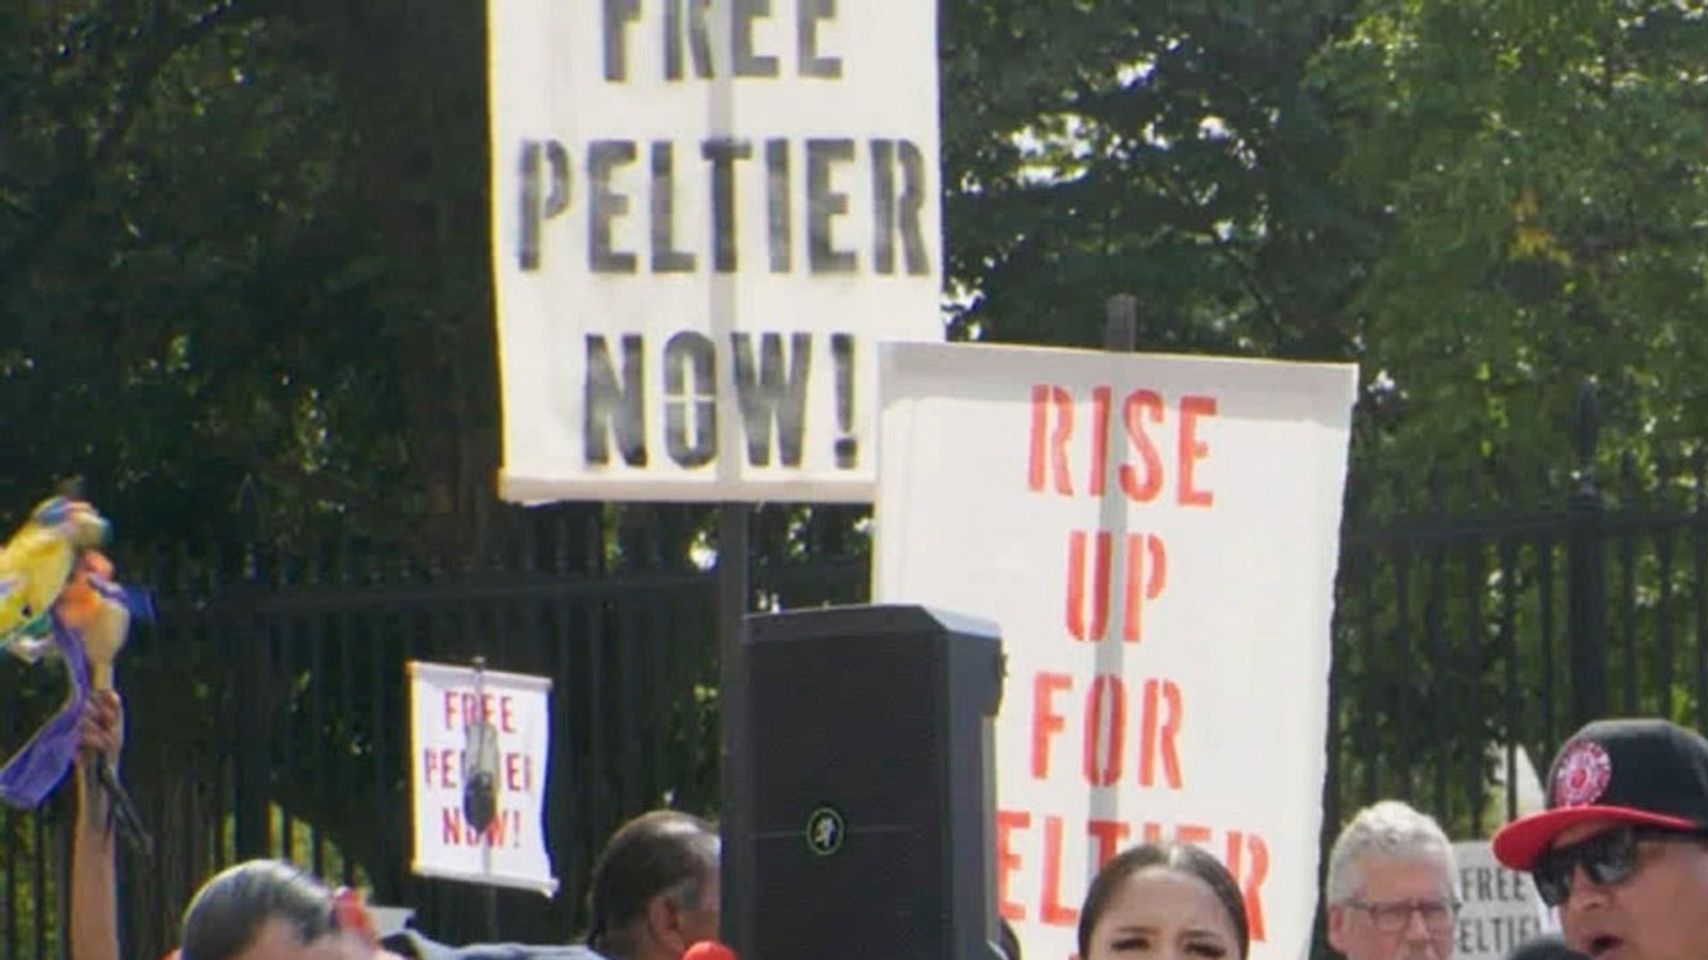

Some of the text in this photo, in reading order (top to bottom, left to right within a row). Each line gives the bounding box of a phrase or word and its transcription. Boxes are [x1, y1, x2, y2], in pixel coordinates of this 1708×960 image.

[602, 0, 844, 82] FREE
[516, 137, 932, 275] PELTIER
[582, 329, 858, 470] NOW!
[1027, 384, 1218, 507] RISE
[1065, 530, 1168, 643] UP
[1029, 672, 1184, 790] FOR
[1461, 867, 1526, 902] FREE
